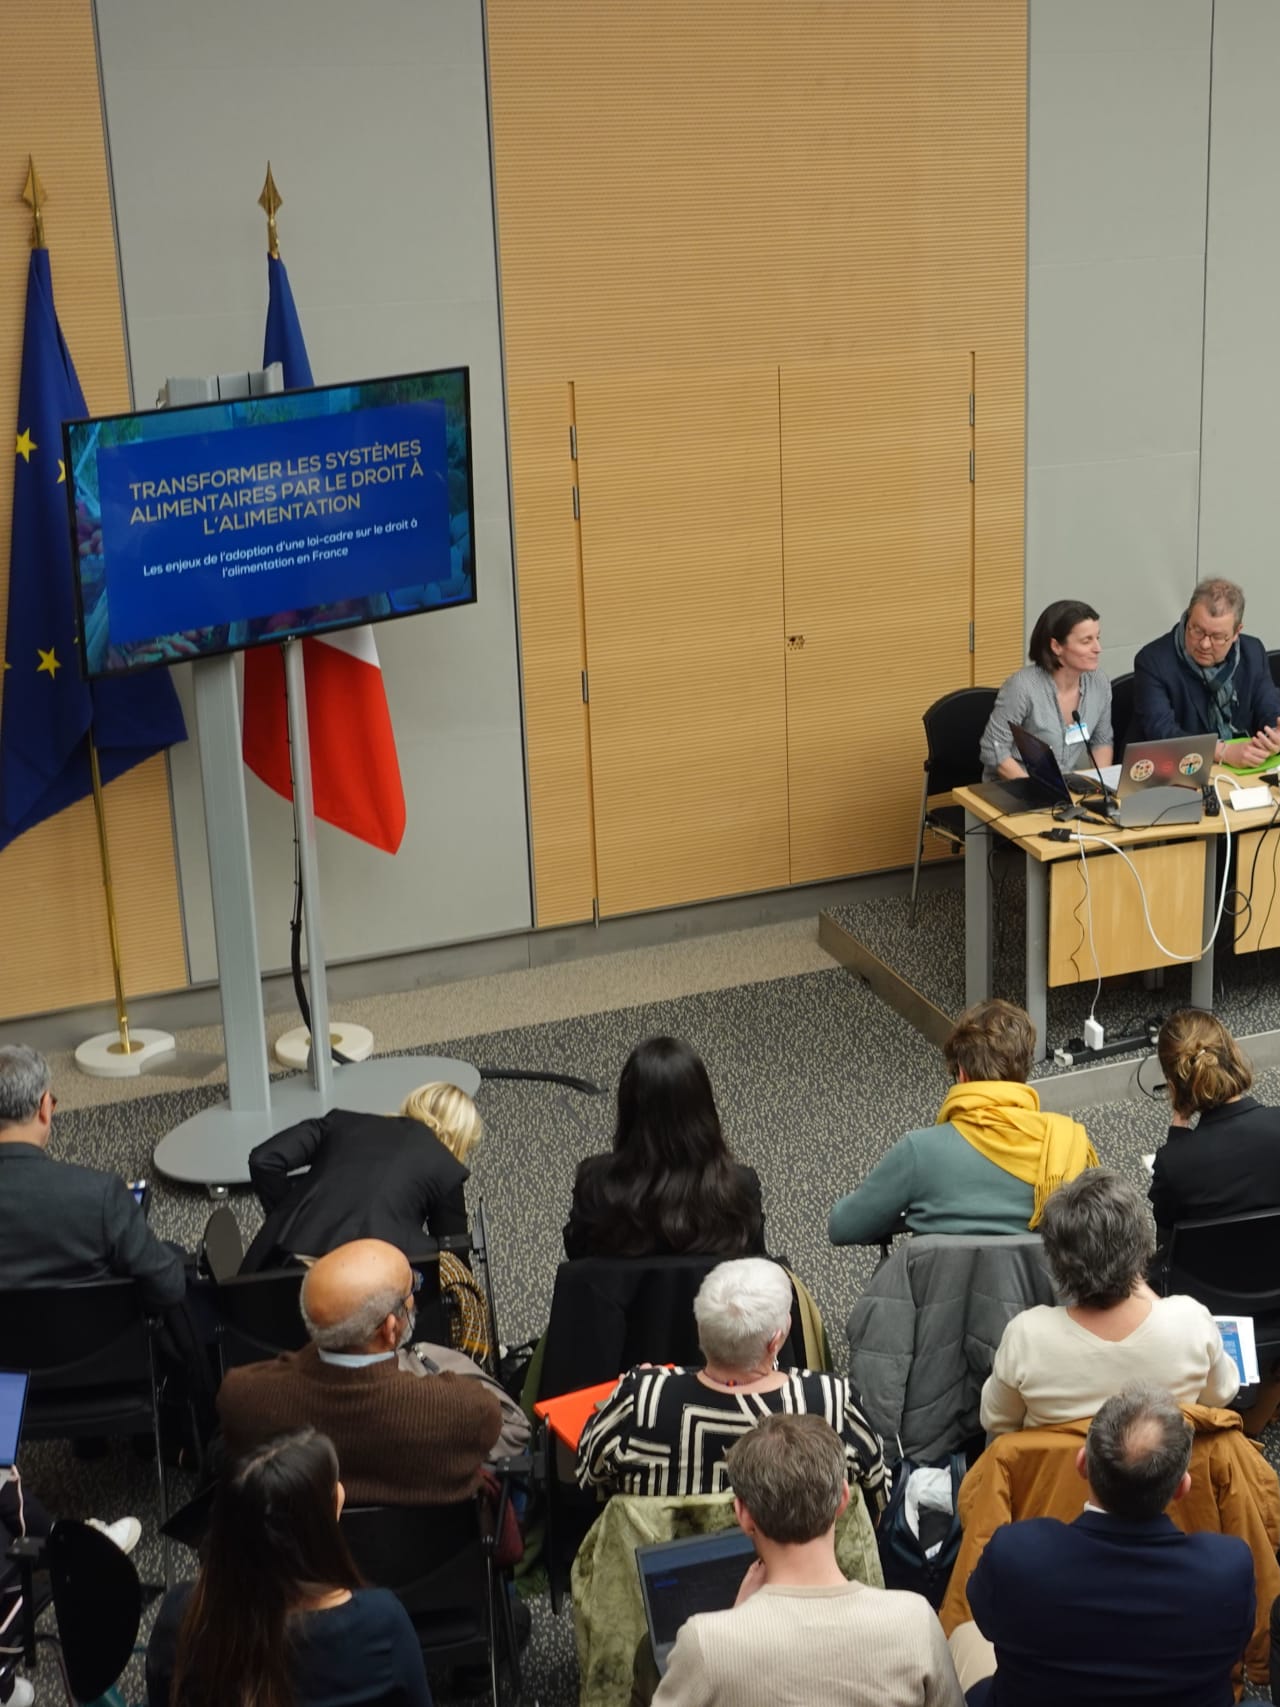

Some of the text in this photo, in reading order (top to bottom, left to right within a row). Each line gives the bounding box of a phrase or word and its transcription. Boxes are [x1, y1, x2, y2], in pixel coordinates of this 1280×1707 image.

[129, 439, 422, 500] TRANSFORMER LES SYSTÈMES
[130, 457, 424, 525] ALIMENTAIRES PAR LE DROIT À
[203, 492, 360, 535] L'ALIMENTATION
[143, 517, 418, 577] Les enjeux de l'adoption d'une loi-cadre sur le droit à
[222, 546, 349, 579] l'alimentation en France
